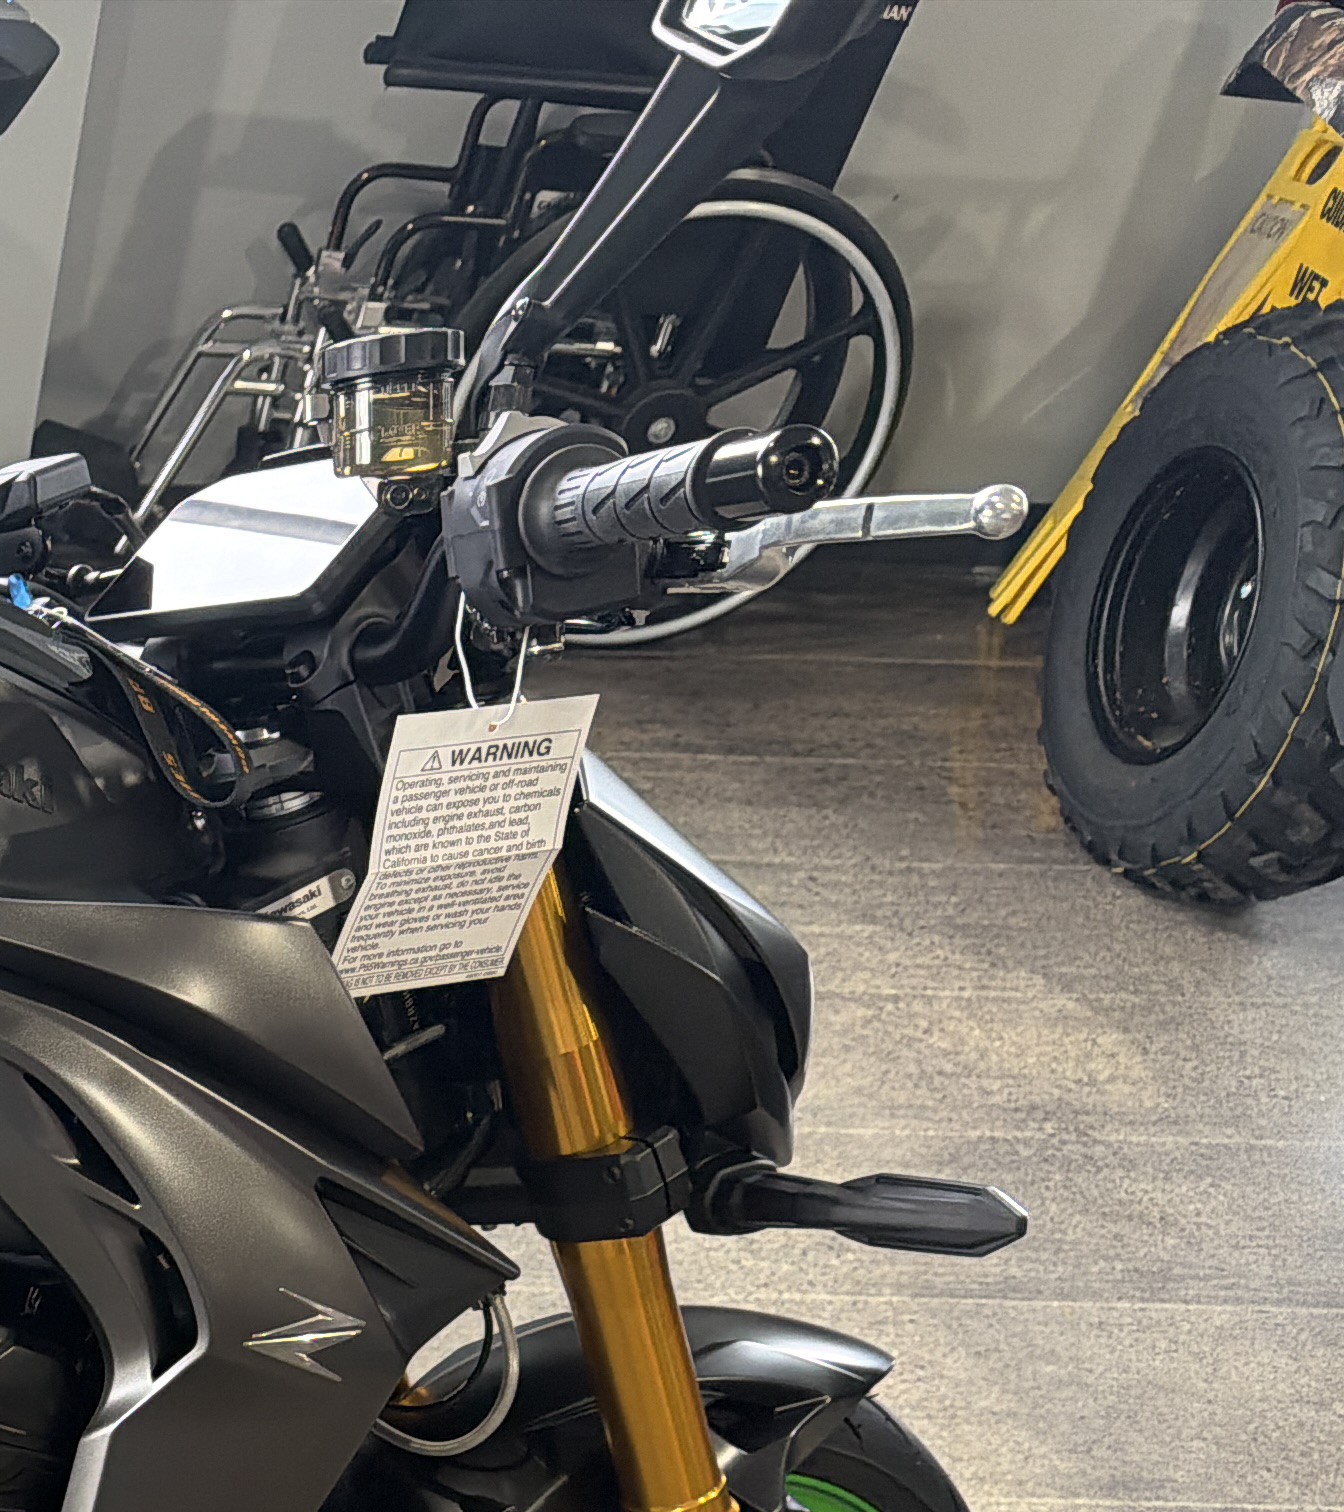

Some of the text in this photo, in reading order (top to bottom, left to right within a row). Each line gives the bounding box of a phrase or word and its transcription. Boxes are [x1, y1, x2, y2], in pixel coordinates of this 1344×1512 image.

[451, 737, 552, 766] WARNING
[392, 776, 539, 804] a passenger vehicle or off-road
[395, 762, 567, 792] Operating, servicing and maintaining
[387, 816, 430, 830] including
[432, 812, 464, 826] engine
[508, 802, 541, 814] carbon
[390, 786, 561, 817] vehicle can expose you to chemicals
[384, 826, 531, 856] which are known to the State of
[385, 829, 434, 843] monoxide,
[487, 818, 506, 830] and
[508, 815, 530, 827] lead,
[382, 838, 546, 869] California to cause cancer and birth
